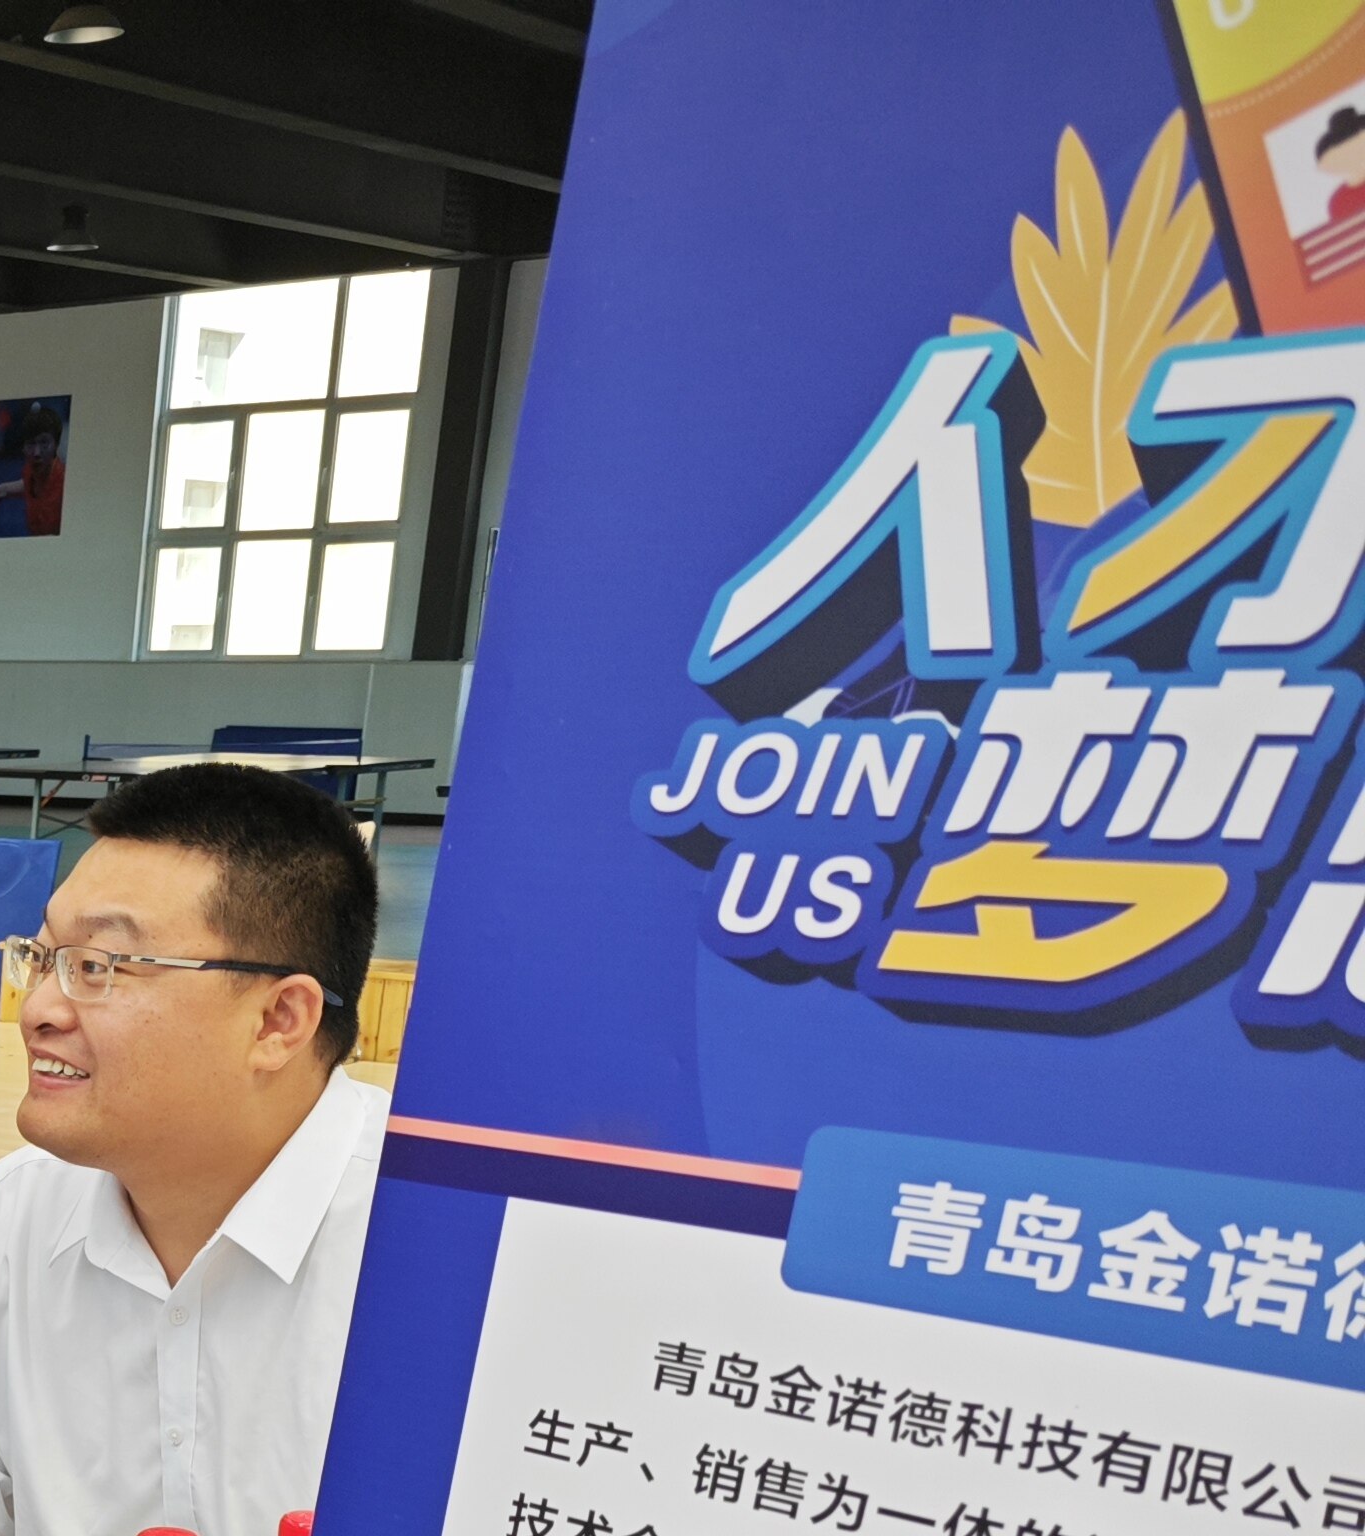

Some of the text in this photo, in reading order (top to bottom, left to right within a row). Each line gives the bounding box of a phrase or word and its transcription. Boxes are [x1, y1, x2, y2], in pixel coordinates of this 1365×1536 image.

[709, 340, 1365, 651] 人才
[650, 733, 925, 818] JOIN
[876, 668, 1365, 1005] 梦
[717, 852, 872, 939] US
